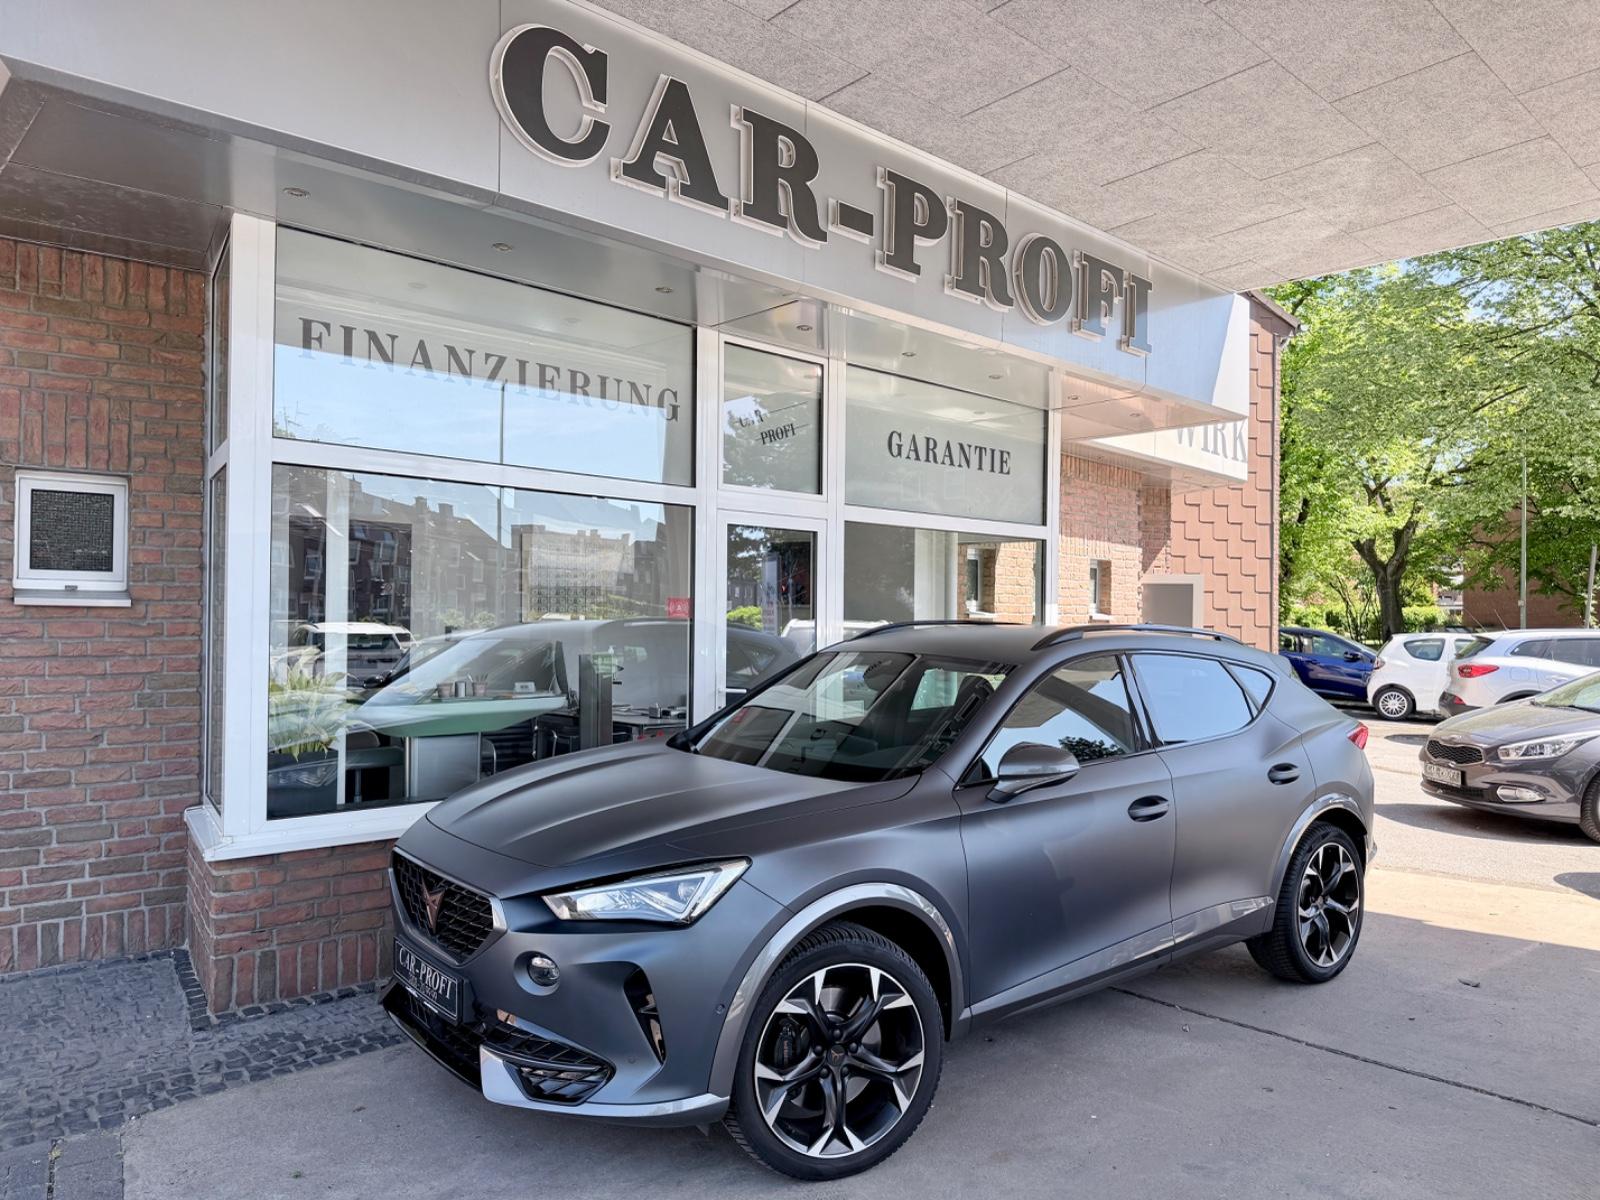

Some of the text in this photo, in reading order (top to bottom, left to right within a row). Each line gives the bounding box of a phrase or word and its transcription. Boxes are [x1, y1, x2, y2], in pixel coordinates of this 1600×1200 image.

[491, 24, 1153, 356] CAR-PROFI
[298, 317, 681, 422] FINANZIERUNG
[760, 422, 797, 446] PROFI
[887, 430, 1012, 476] GARANTIE
[399, 946, 453, 1000] CAR-PROFI
